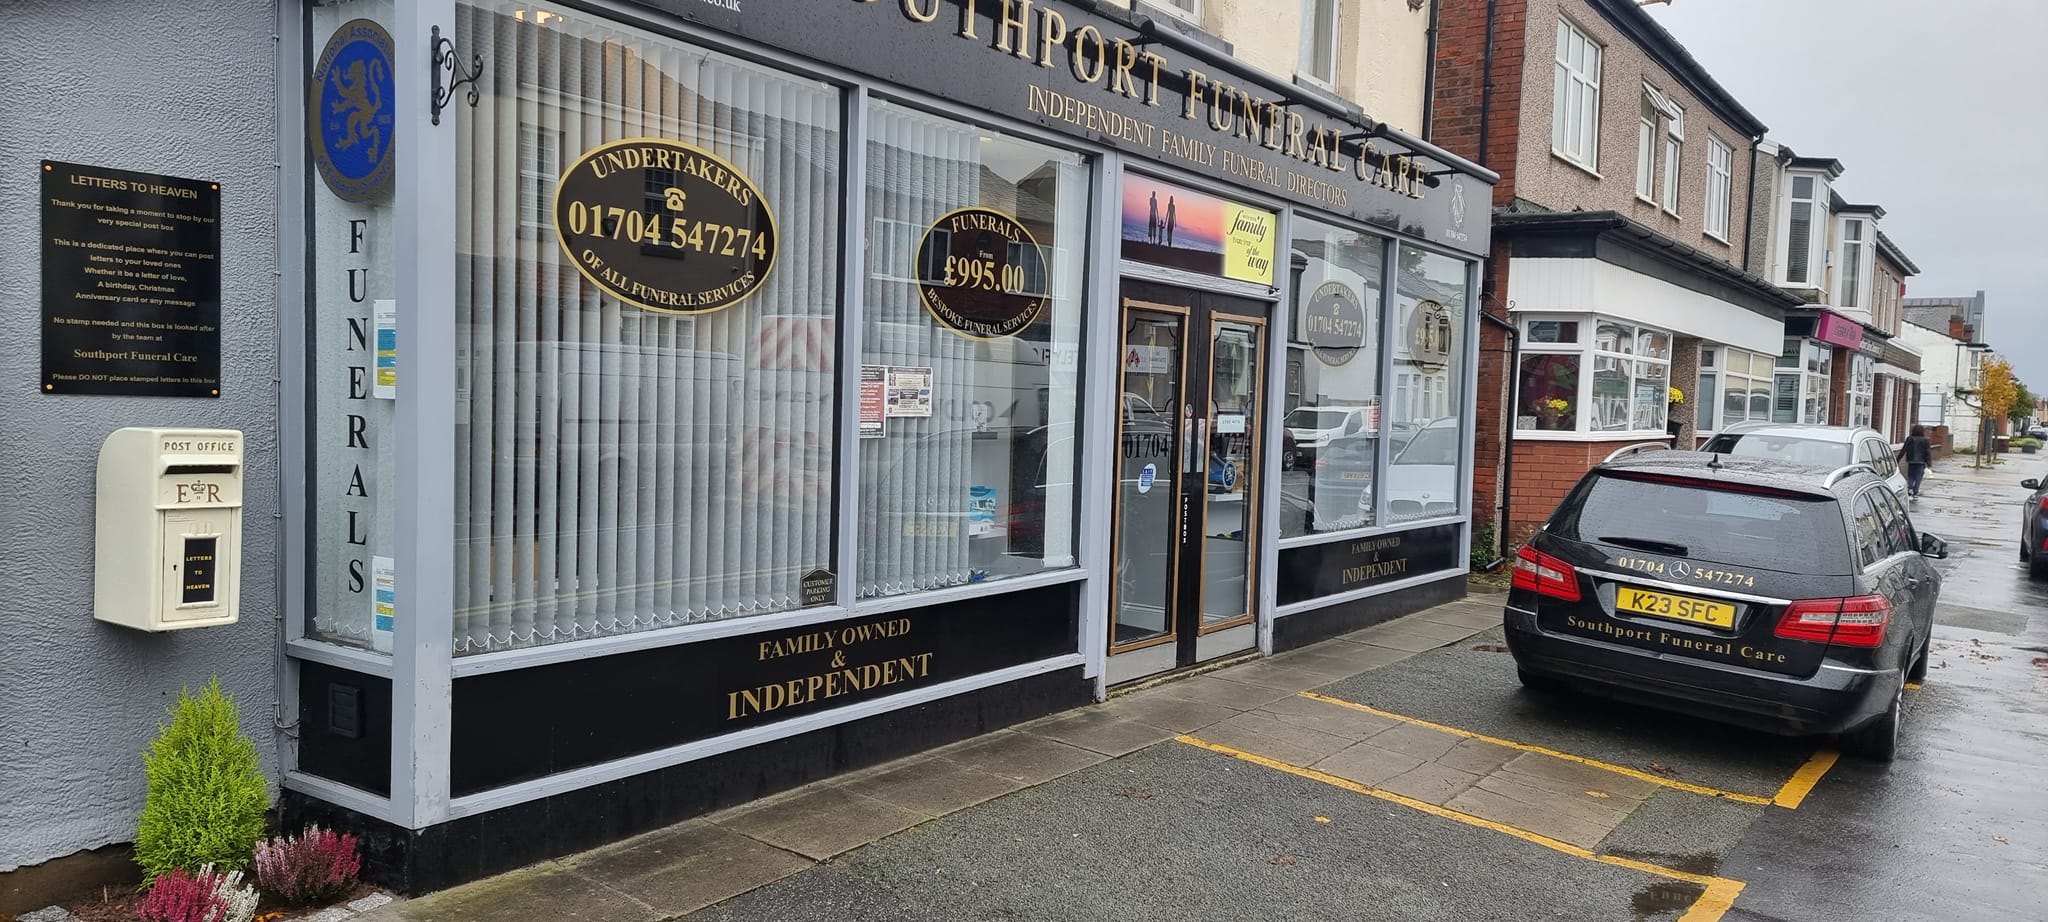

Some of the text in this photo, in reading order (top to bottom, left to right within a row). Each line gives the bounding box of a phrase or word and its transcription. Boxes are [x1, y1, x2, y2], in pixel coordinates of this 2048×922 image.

[1187, 68, 1347, 172] FUNERAL
[1361, 142, 1427, 199] CARE
[1027, 84, 1347, 208] INDEPENDENT FAMILY FUNERAL DIRECTORS
[71, 174, 198, 199] LETTERS TO HEAVEN
[589, 147, 753, 207] UNDERTAKERS
[51, 198, 76, 208] Thank
[77, 202, 92, 210] you
[93, 203, 104, 211] for
[105, 205, 129, 215] taking
[136, 209, 166, 218] moment
[192, 215, 202, 223] by
[97, 218, 114, 226] very
[115, 219, 142, 227] special
[160, 223, 174, 231] box
[568, 200, 767, 261] 01704 547274
[951, 213, 1022, 244] FUNERALS
[1226, 209, 1268, 243] family
[53, 238, 70, 246] This
[87, 241, 124, 251] dedicated
[125, 245, 145, 253] place
[146, 247, 168, 255] where
[978, 250, 994, 260] From
[90, 254, 114, 263] letters
[143, 259, 163, 267] loved
[1247, 256, 1269, 276] way
[84, 267, 116, 276] Whether
[141, 271, 160, 279] letter
[170, 274, 187, 282] love,
[581, 248, 756, 306] OF ALL FUNERAL SERVICES
[943, 255, 1025, 294] £995.00
[75, 291, 121, 302] Anniversary
[149, 298, 163, 306] any
[164, 299, 196, 308] message
[138, 284, 175, 293] Christmas
[1314, 283, 1360, 310] UNDERTAKERS
[927, 287, 1037, 335] BESPOKE FUNERAL SERVICES
[53, 316, 65, 324] No
[66, 318, 90, 326] stamp
[120, 320, 135, 328] and
[174, 323, 198, 332] looked
[1308, 314, 1362, 338] 01704 547274
[111, 333, 122, 341] by
[73, 348, 198, 362] Southport Funeral Care
[129, 375, 159, 383] stamped
[346, 219, 369, 594] FUNERALS
[164, 441, 235, 452] POST OFFICE
[1124, 433, 1169, 459] 01704
[176, 483, 191, 504] E
[207, 483, 224, 503] R
[1351, 536, 1401, 555] FAMILY OWNED
[1373, 551, 1379, 562] &
[803, 578, 833, 588] CUSTOMER
[1342, 557, 1407, 585] INDEPENDENT
[1619, 556, 1755, 587] 01704 547274
[806, 586, 831, 596] PARKING
[810, 594, 826, 602] ONLY
[1631, 591, 1720, 623] K23 SFC
[758, 617, 911, 661] FAMILY OWNED
[1567, 614, 1786, 663] Southport Funeral Care
[830, 649, 847, 669] &
[726, 652, 933, 721] INDEPENDENT
